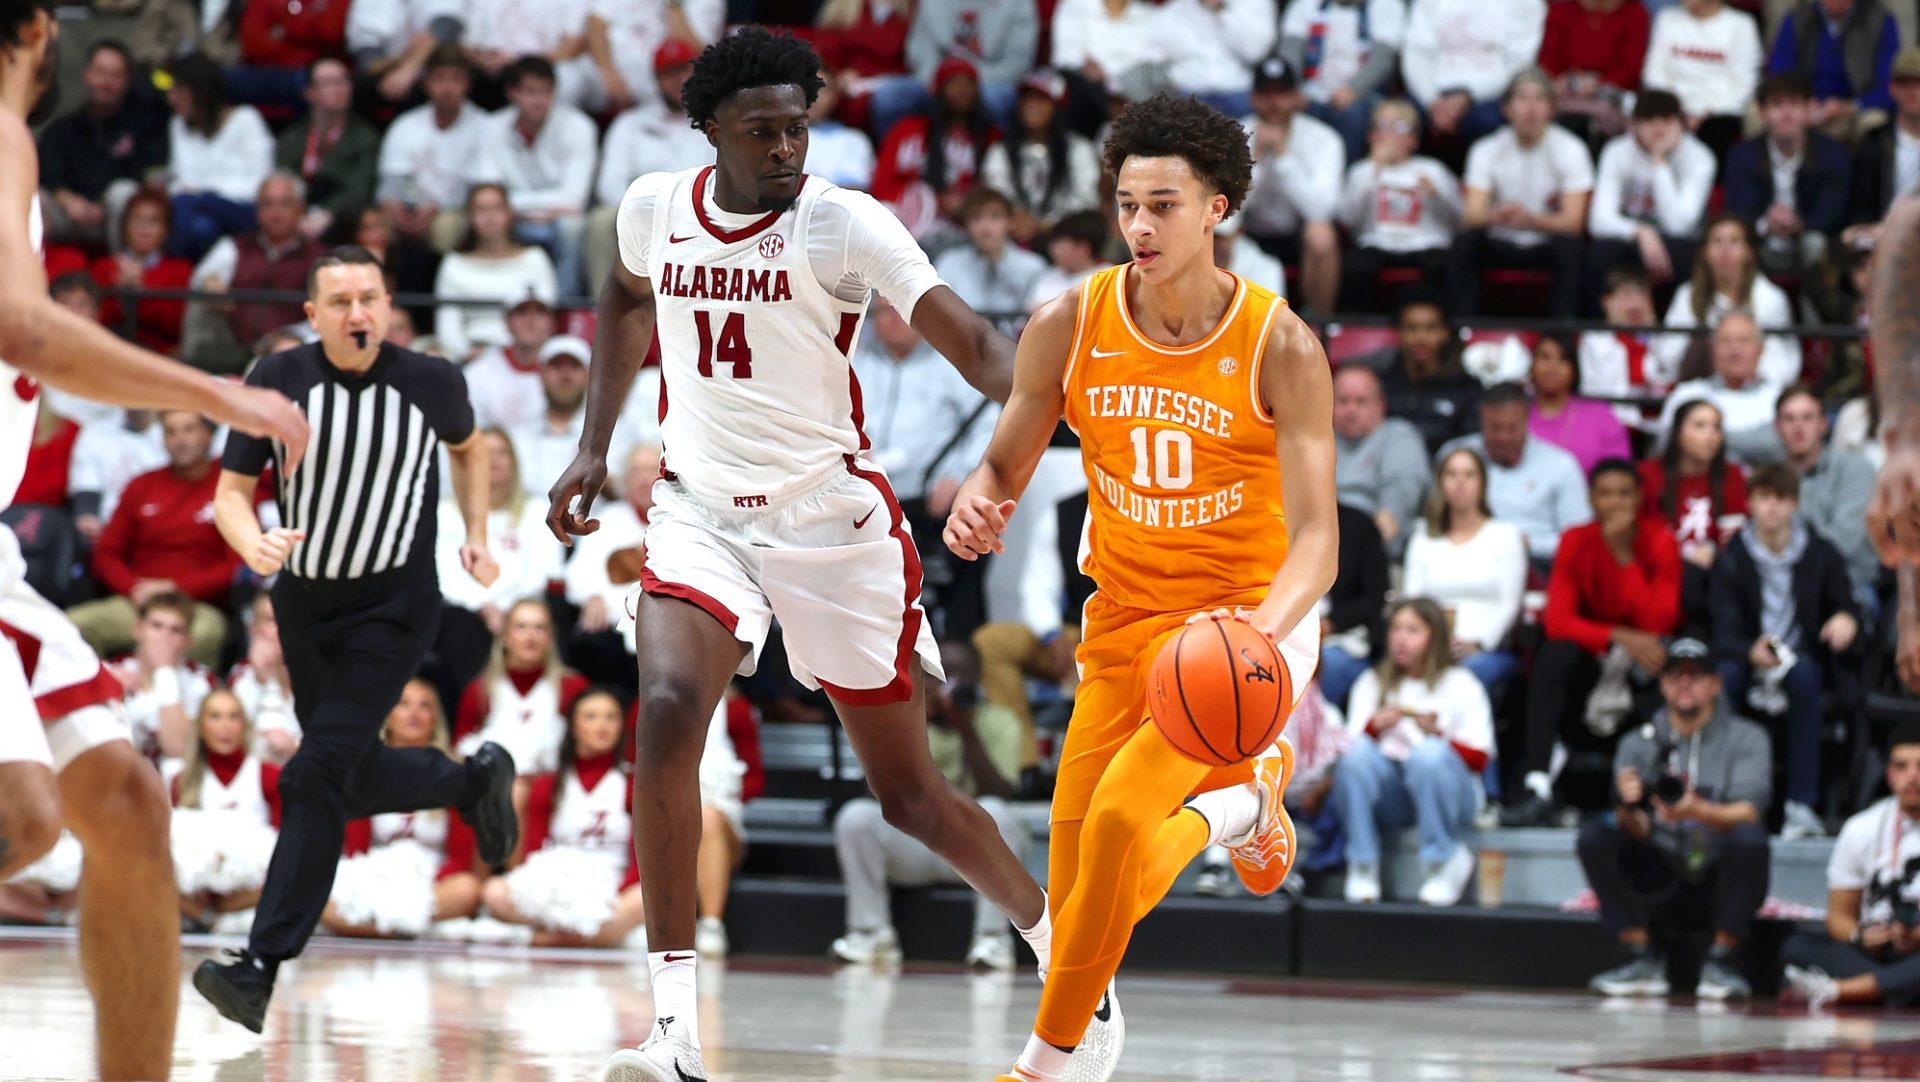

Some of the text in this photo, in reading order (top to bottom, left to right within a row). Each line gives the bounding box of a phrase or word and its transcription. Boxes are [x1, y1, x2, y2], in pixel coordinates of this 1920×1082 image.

[760, 234, 784, 258] SEC
[660, 262, 793, 302] ALABAMA
[694, 310, 752, 379] 14
[1219, 356, 1238, 376] SEC
[1086, 385, 1234, 439] TENNESSEE
[1130, 426, 1193, 490] 10
[732, 495, 769, 508] RTR
[1092, 462, 1245, 528] VOLUNTEERS
